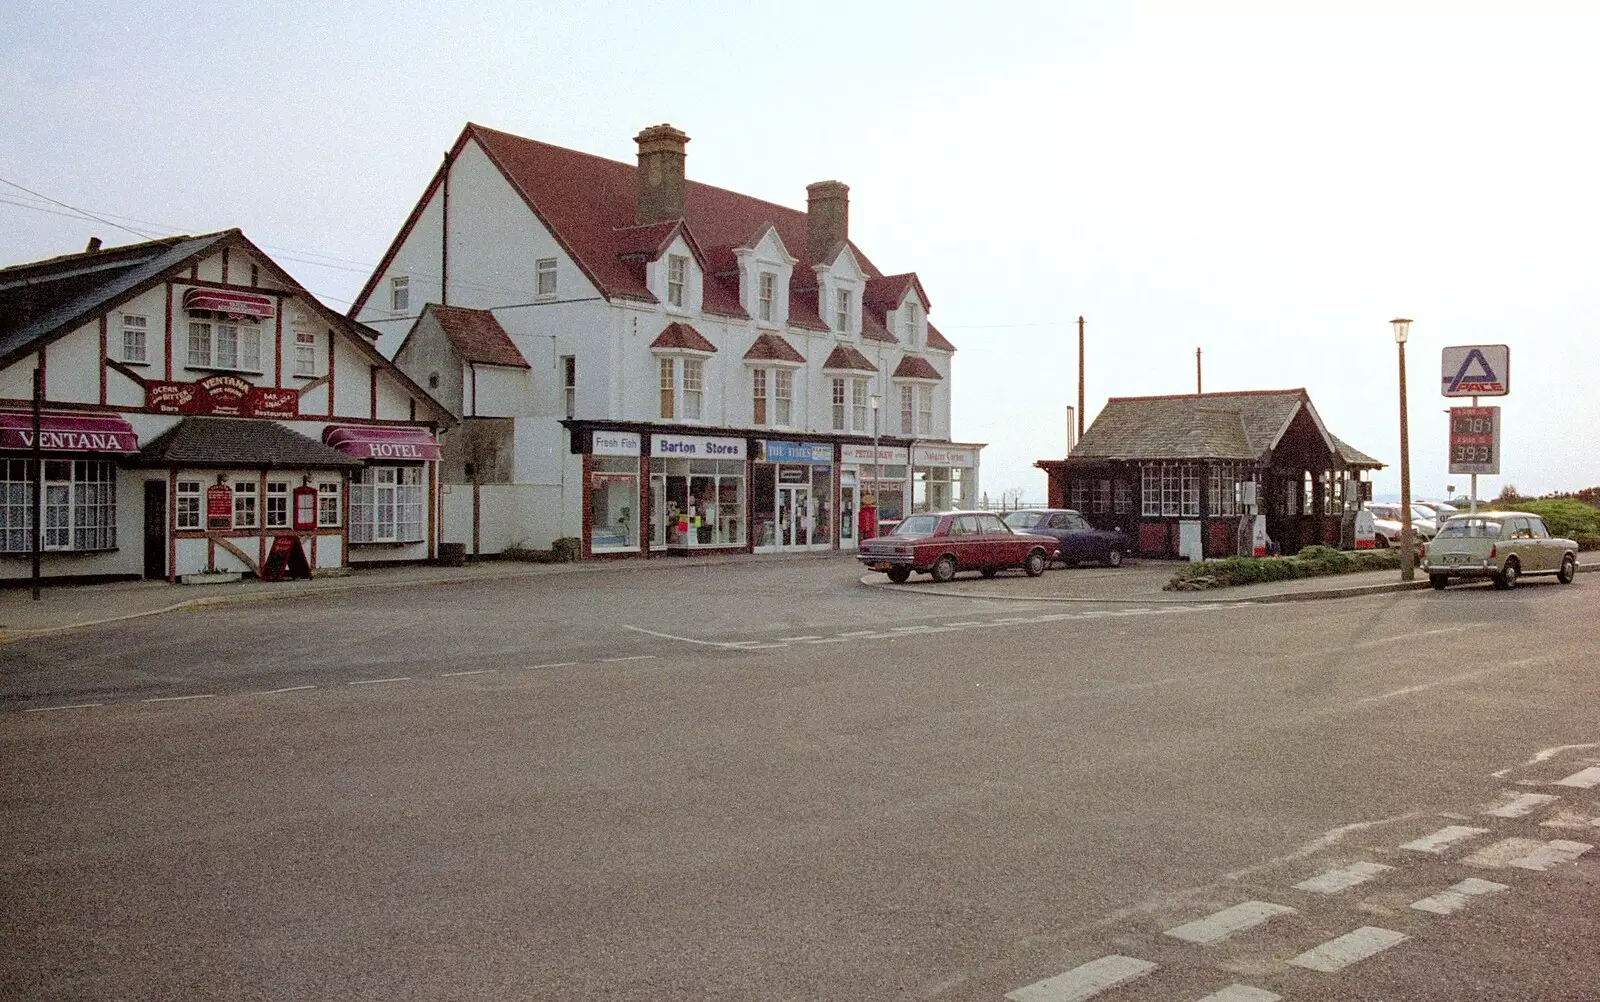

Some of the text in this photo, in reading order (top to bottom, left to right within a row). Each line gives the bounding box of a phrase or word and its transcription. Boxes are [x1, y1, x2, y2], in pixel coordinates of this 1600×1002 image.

[202, 376, 250, 394] VENTANA
[1456, 383, 1504, 392] PACE
[18, 431, 122, 450] VENTANA
[596, 437, 637, 449] Fresh Fish
[660, 440, 739, 455] Barton Stores
[368, 443, 422, 457] HOTEL
[768, 445, 784, 457] THE
[788, 446, 811, 458] TIMES
